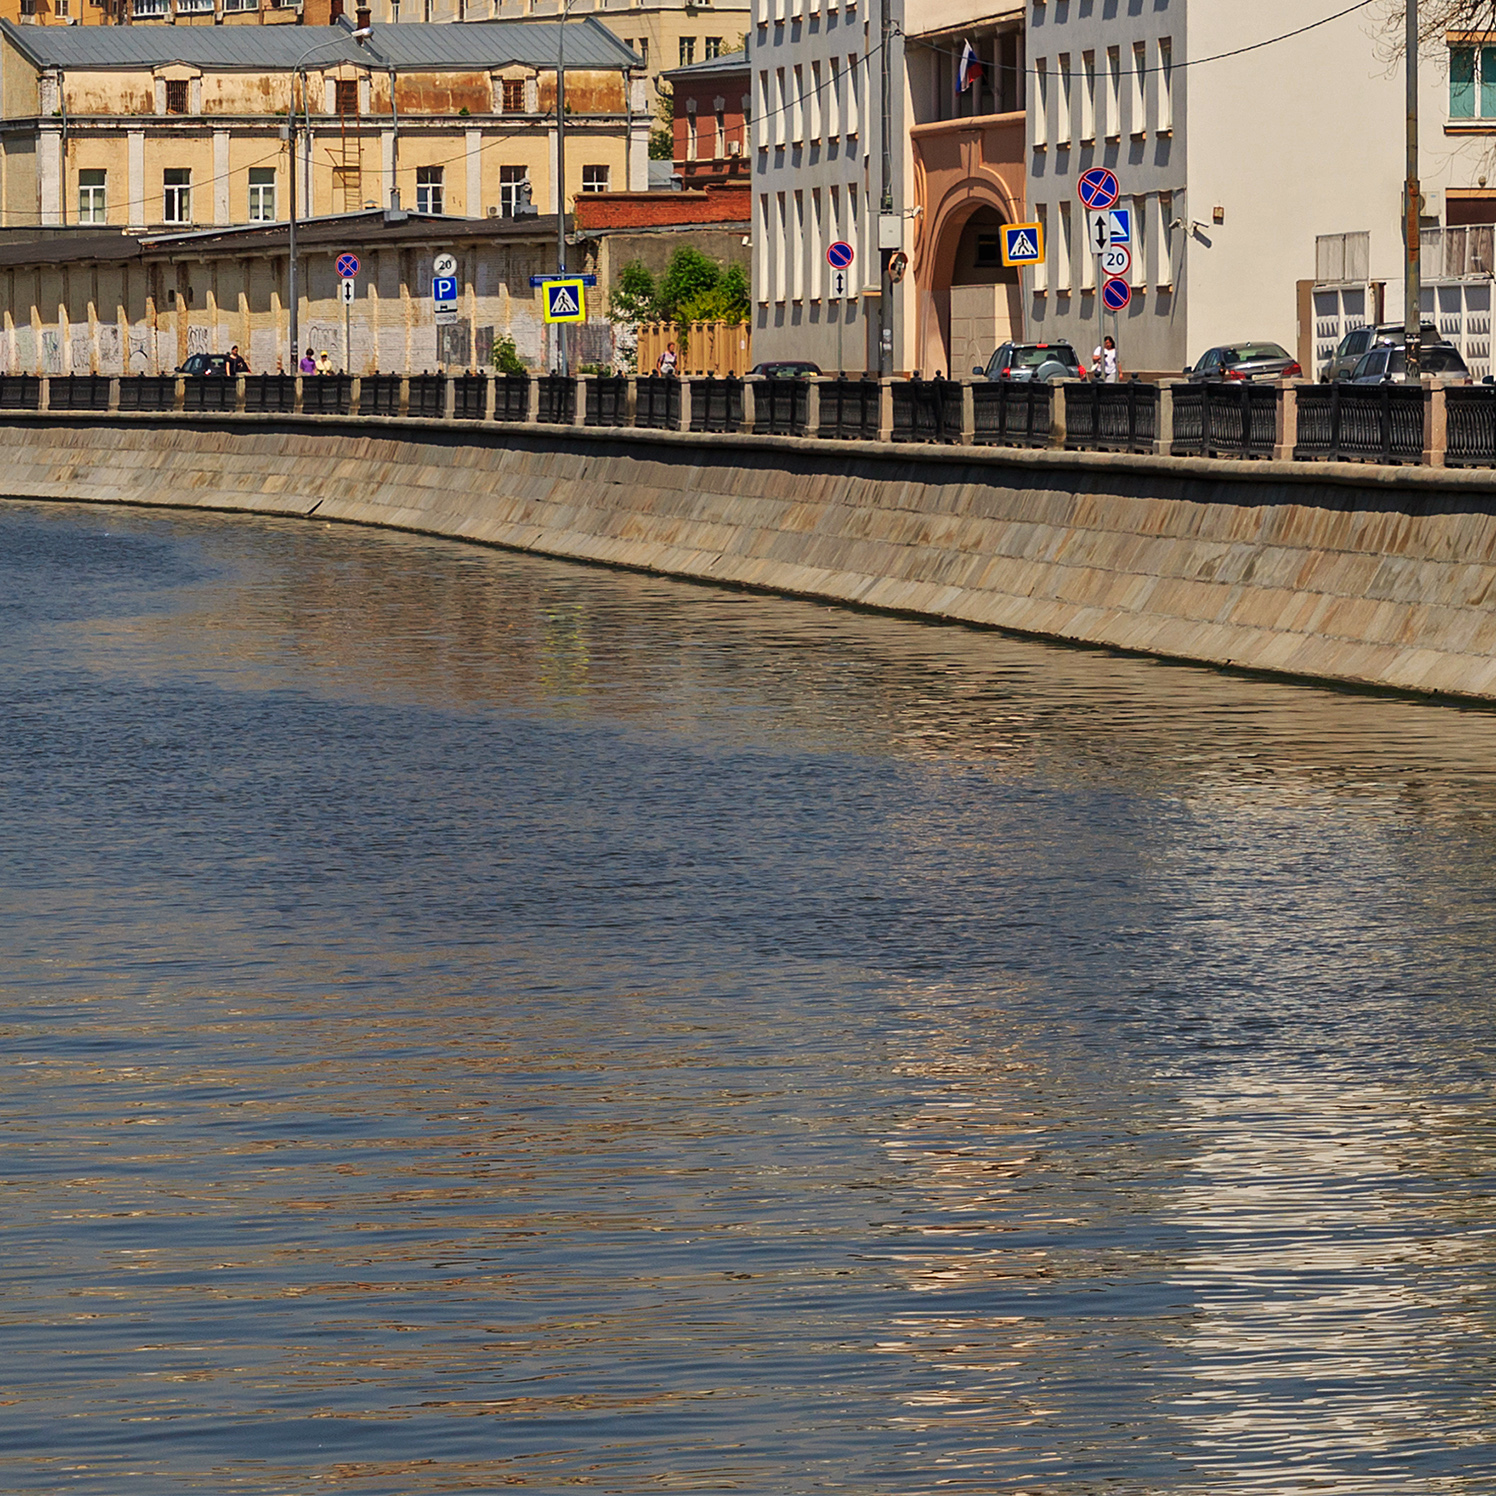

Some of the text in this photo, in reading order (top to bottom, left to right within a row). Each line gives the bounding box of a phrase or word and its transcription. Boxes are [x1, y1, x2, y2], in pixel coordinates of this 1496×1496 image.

[439, 260, 452, 270] 20
[1106, 252, 1125, 266] 20
[438, 280, 452, 299] P
